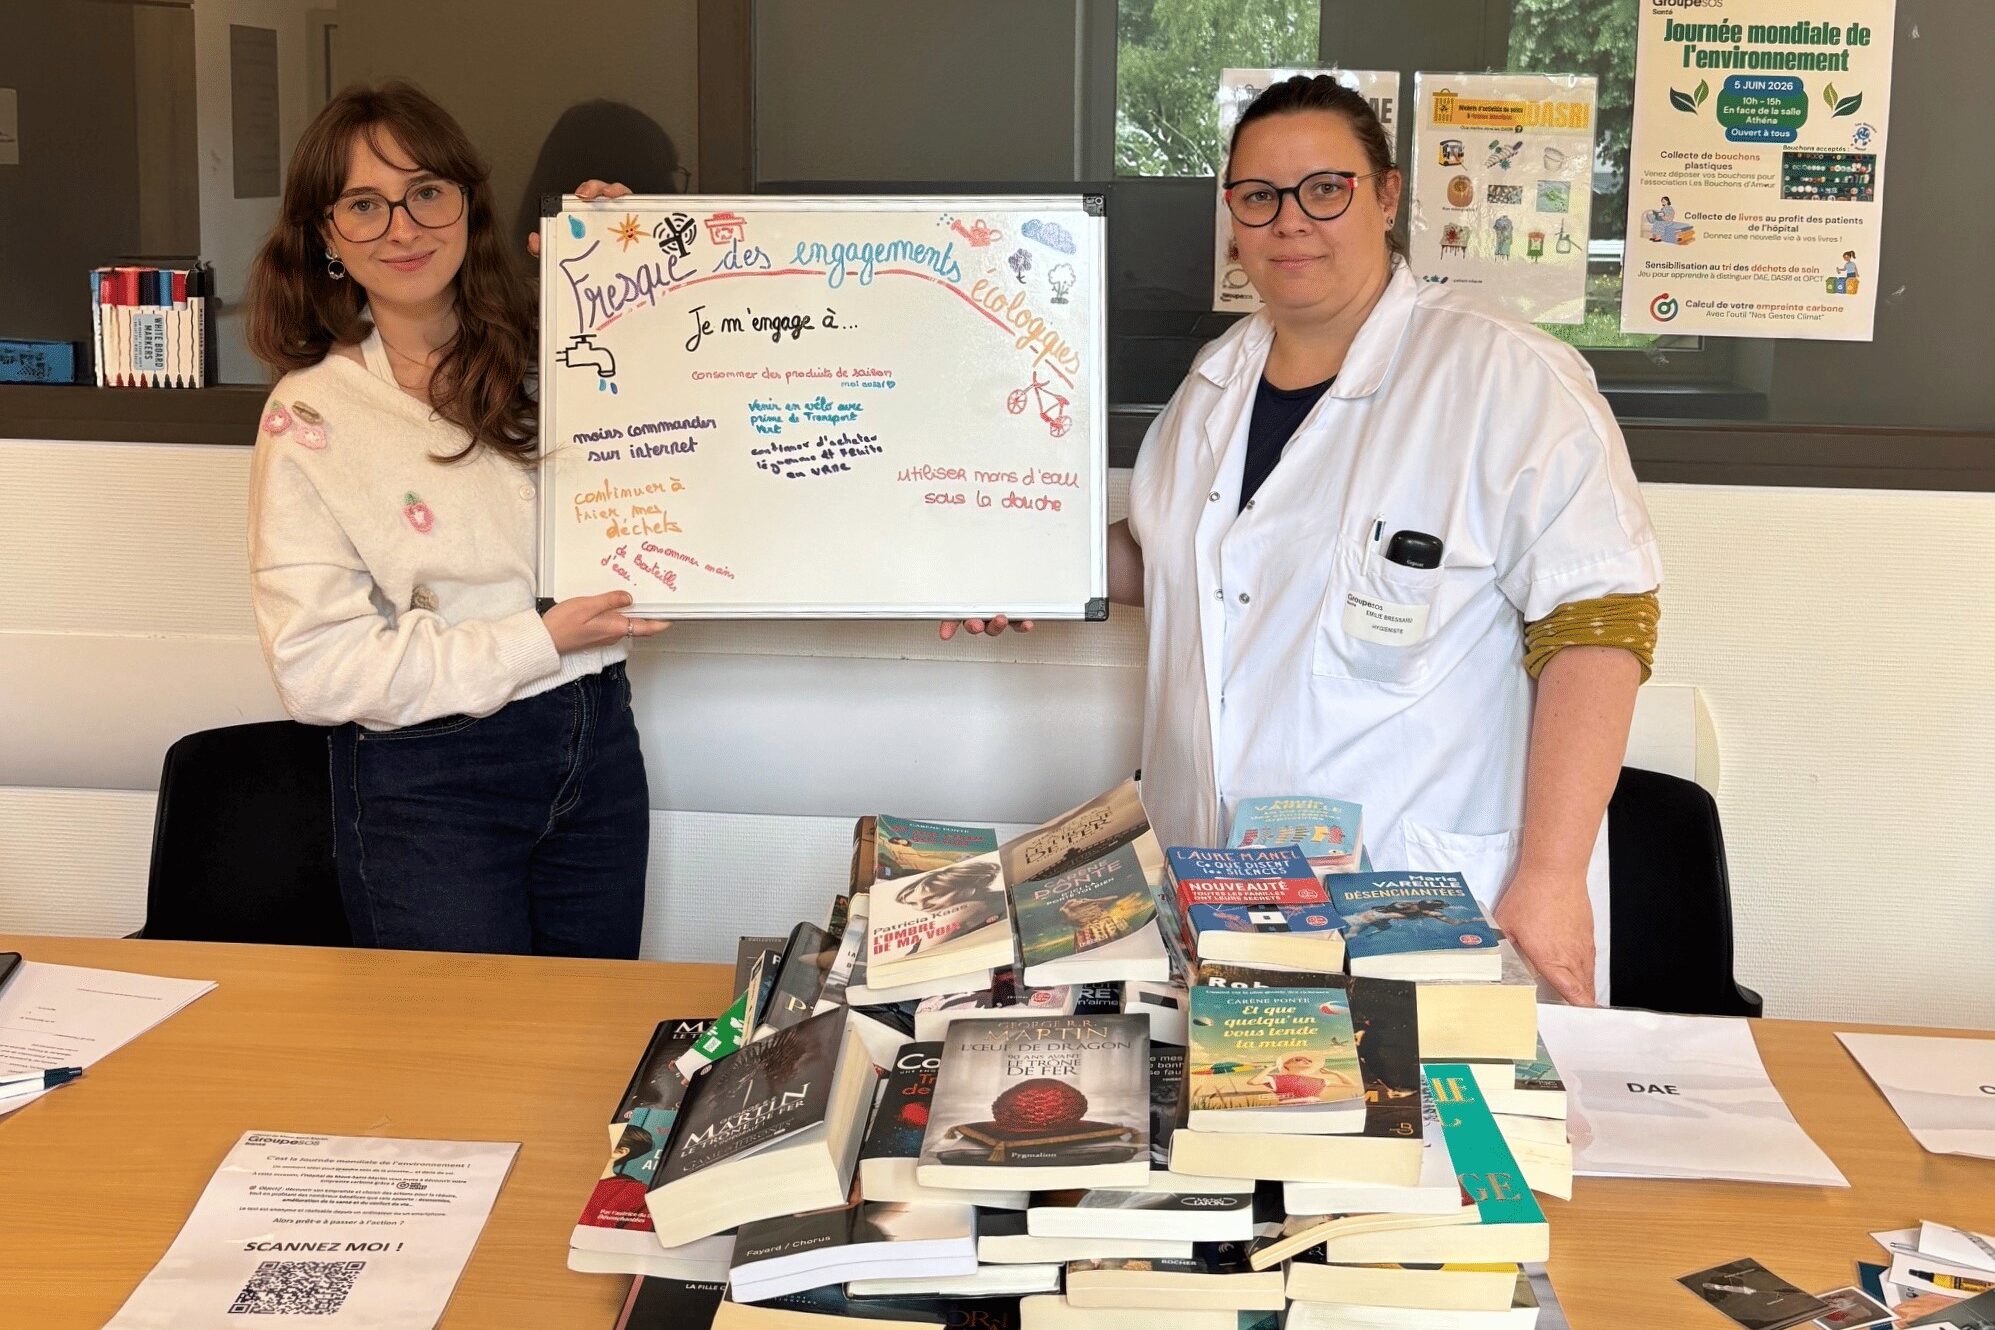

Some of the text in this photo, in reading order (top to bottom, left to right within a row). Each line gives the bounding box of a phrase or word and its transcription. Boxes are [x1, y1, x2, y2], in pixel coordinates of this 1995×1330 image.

[1664, 18, 1871, 46] Journée mondiale de
[1683, 44, 1849, 71] l'environnement
[1734, 81, 1793, 91] 5 JUIN 2026
[1526, 102, 1589, 129] DASRI
[1723, 106, 1801, 116] En face de la salle
[1731, 128, 1790, 139] Ouvert à tous
[1660, 151, 1760, 161] Collecte de bouchons
[1685, 161, 1733, 171] plastiques
[1668, 170, 1700, 179] déposer
[1717, 171, 1755, 180] bouchons
[1684, 212, 1723, 221] Collecte
[1725, 212, 1737, 221] de
[1738, 213, 1763, 222] livres
[1778, 214, 1804, 224] profit
[1806, 215, 1823, 224] des
[1825, 215, 1864, 225] patients
[1748, 223, 1799, 233] de l'hôpital
[1645, 261, 1820, 274] Sensibilisation au tri des déchets de soin
[559, 238, 1080, 374] Fresque des engagements écologiques
[1685, 300, 1844, 313] Calcul de votre empreinte carbone
[685, 305, 714, 352] Je
[721, 308, 815, 343] m'engage
[144, 325, 153, 360] MARKERS
[155, 318, 163, 368] WHITE BOARD
[691, 367, 893, 385] consommer des produits de saison
[785, 402, 801, 412] en
[573, 415, 717, 444] moins commander
[587, 437, 698, 462] sur internet
[1022, 467, 1080, 489] d'eau
[574, 476, 686, 505] continuer à
[924, 490, 1062, 512] sous la douche
[575, 504, 663, 523] trier mes
[606, 510, 683, 539] déchets
[1176, 849, 1300, 861] LAURE MANEL
[1215, 860, 1239, 870] QUE
[1250, 860, 1290, 870] DISENT
[1226, 867, 1287, 876] SILENCES
[1371, 880, 1463, 888] VAREILLE
[1408, 874, 1457, 882] Marie
[1188, 880, 1289, 892] NOUVEAUTÉ
[1344, 887, 1465, 901] DÉSENCHANTÉES
[873, 903, 969, 936] Patricia Kaas
[873, 920, 937, 947] L'OMBRE
[873, 942, 892, 955] DE
[897, 934, 920, 948] MA
[1242, 1005, 1296, 1016] Et que
[998, 1019, 1098, 1029] GEORGE R.R.
[986, 1027, 1109, 1042] MARTIN
[1223, 1027, 1319, 1038] vous tende
[1018, 1042, 1041, 1052] DE
[1047, 1041, 1132, 1051] DRAGON
[1234, 1038, 1308, 1049] ta main
[1028, 1058, 1081, 1067] TRÔNE
[1006, 1066, 1080, 1076] DE FER
[901, 1083, 930, 1096] de
[1626, 1082, 1682, 1097] DAE
[779, 1100, 805, 1115] FER
[683, 1081, 812, 1150] MARTIN
[248, 1135, 320, 1146] Groupesos
[1011, 1152, 1057, 1160] Pygmalion
[243, 1241, 404, 1252] SCANNEZ MOI !
[746, 1235, 832, 1258] Fayard Chorus
[697, 1283, 720, 1291] FILLE
